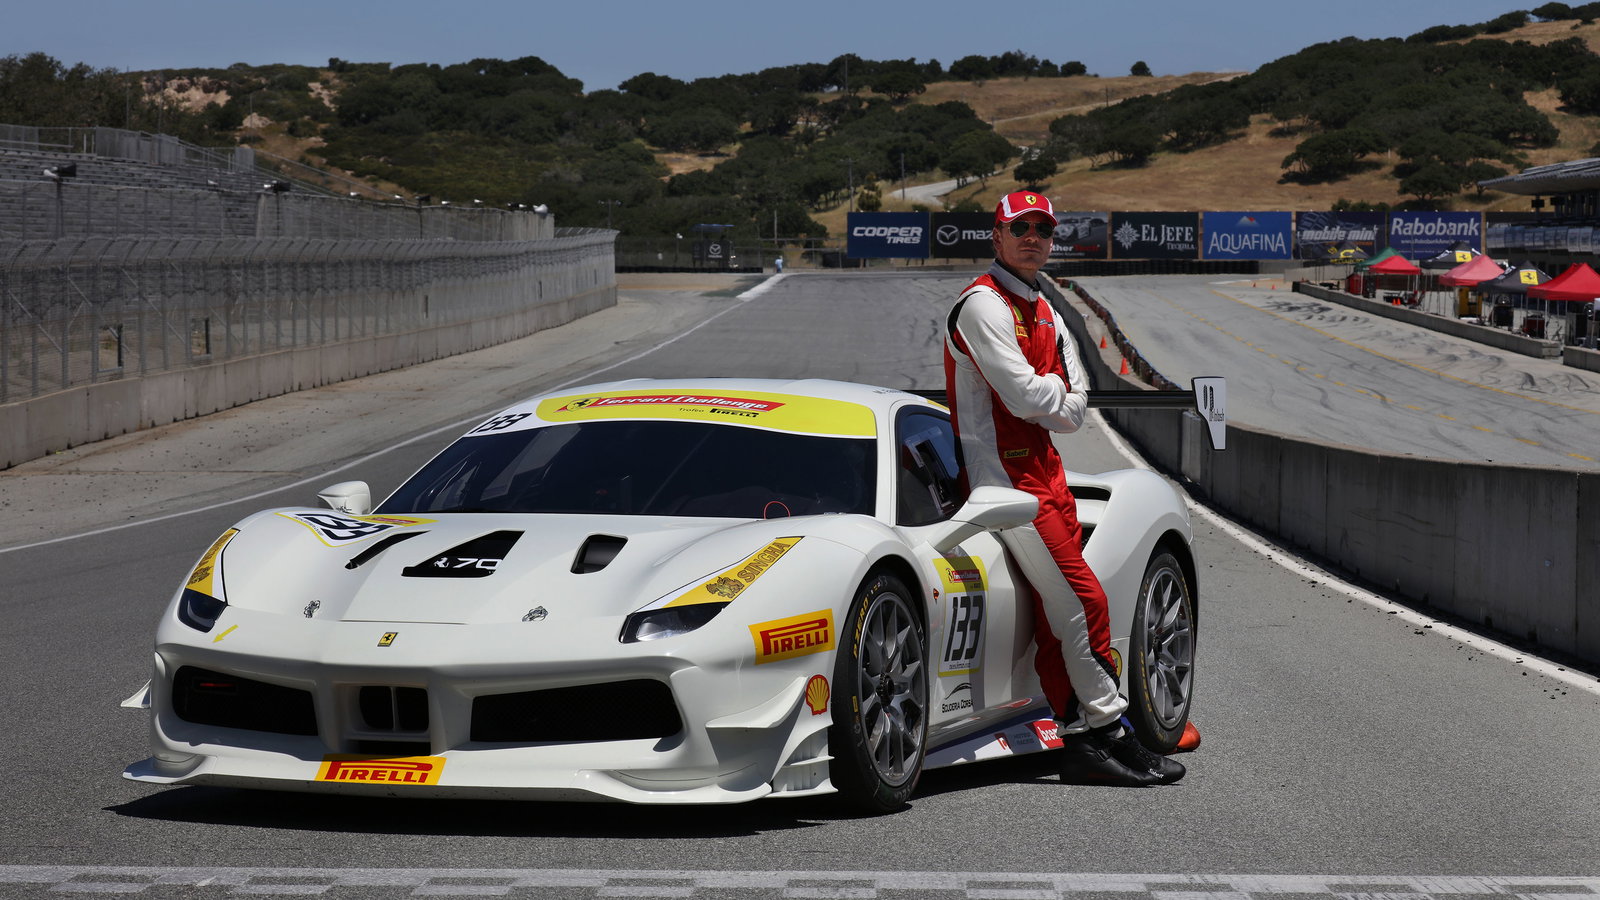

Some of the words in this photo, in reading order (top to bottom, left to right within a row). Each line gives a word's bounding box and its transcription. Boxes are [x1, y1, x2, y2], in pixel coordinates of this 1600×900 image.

[852, 226, 923, 237] COOPER
[962, 230, 993, 240] maz
[1141, 224, 1158, 242] EL
[1159, 224, 1194, 246] JEFE
[1301, 225, 1346, 241] mobile
[1391, 217, 1480, 237] Rabobank
[886, 236, 921, 244] TIRES
[1208, 231, 1287, 254] AQUAFINA
[597, 396, 673, 405] Ferrari
[672, 395, 769, 409] Challenge
[709, 408, 760, 418] PIRELLI
[468, 412, 533, 435] 133
[453, 557, 504, 571] 70
[737, 542, 791, 583] SINGHA
[760, 618, 829, 656] PIRELLI
[944, 594, 984, 662] 133
[324, 760, 433, 783] PIRELLI
